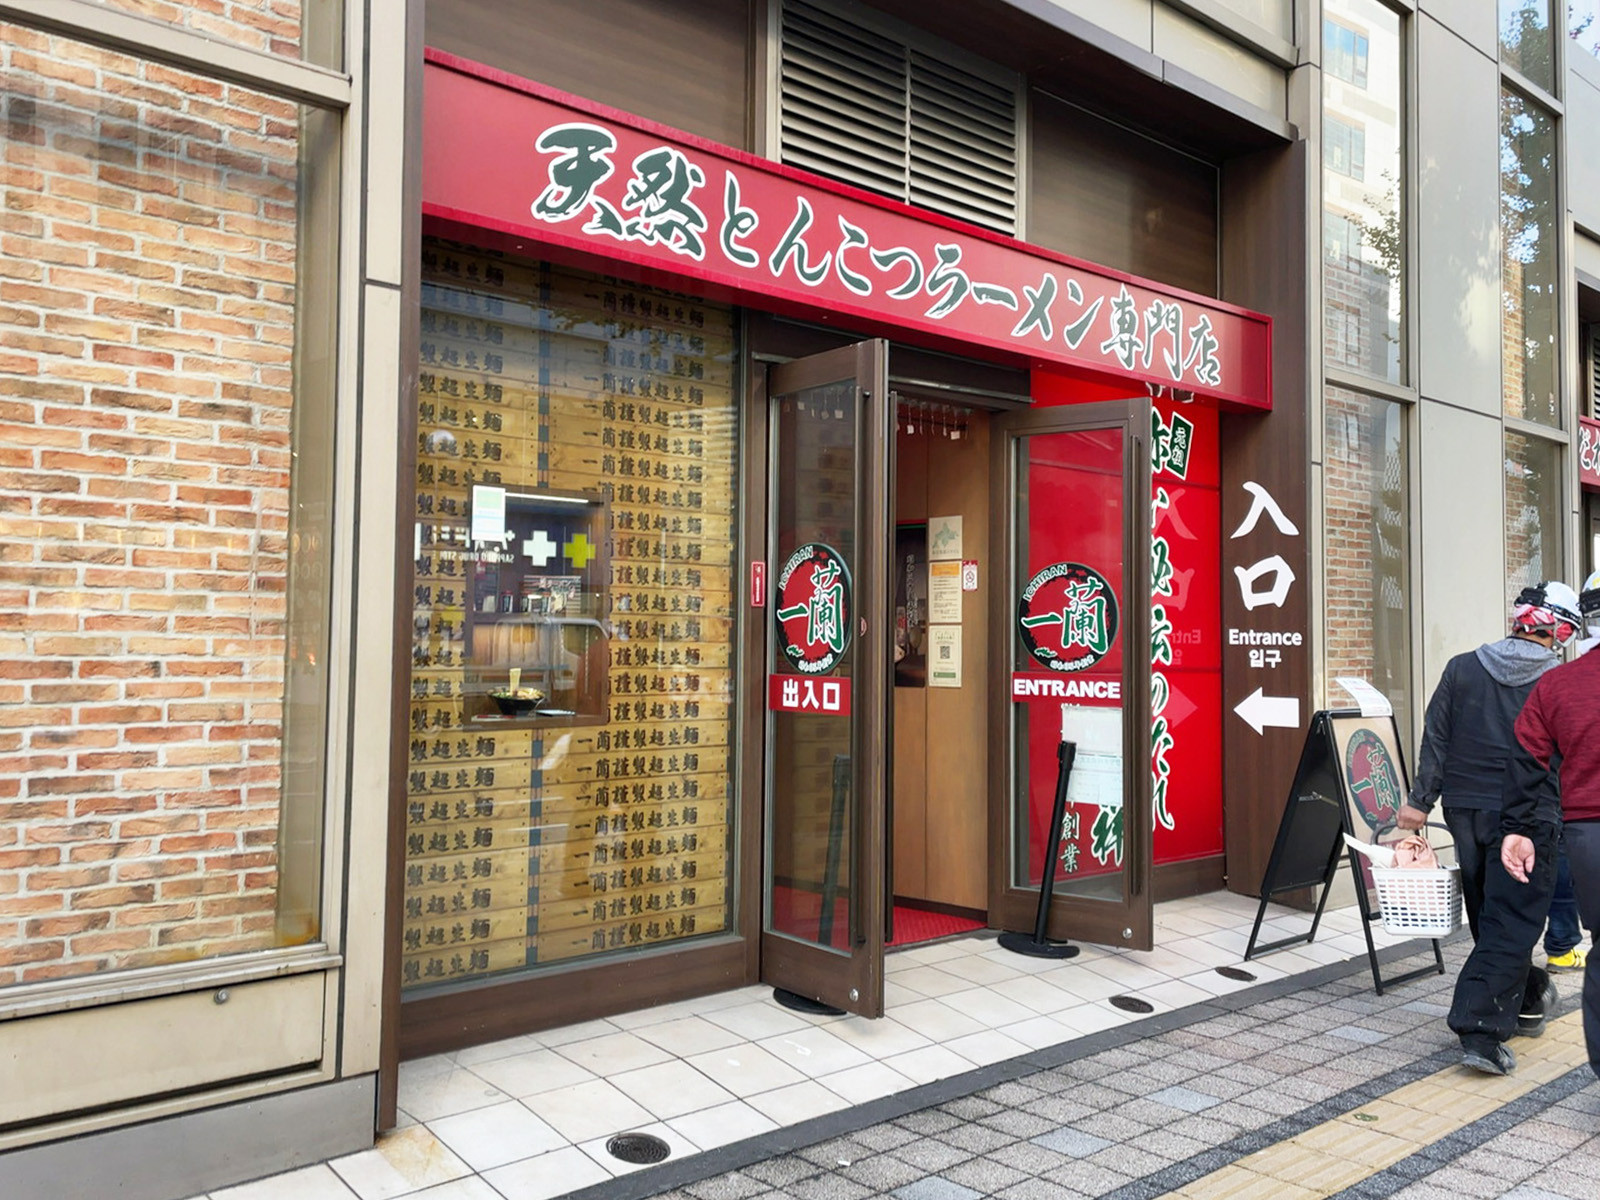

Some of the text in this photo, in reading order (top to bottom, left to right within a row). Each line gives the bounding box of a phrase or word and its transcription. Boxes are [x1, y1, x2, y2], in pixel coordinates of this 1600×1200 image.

[531, 122, 1221, 386] 天然とんこつラーメン専門店
[1230, 481, 1300, 611] 入口
[777, 559, 845, 654] 一蘭
[1022, 564, 1068, 602] ICHIRAN
[1021, 576, 1109, 654] 一蘭
[1228, 628, 1302, 646] Entrance
[1249, 649, 1282, 669] 입구
[782, 678, 841, 711] 出入口
[1013, 678, 1121, 699] ENTRANCE
[1060, 801, 1081, 873] 創業
